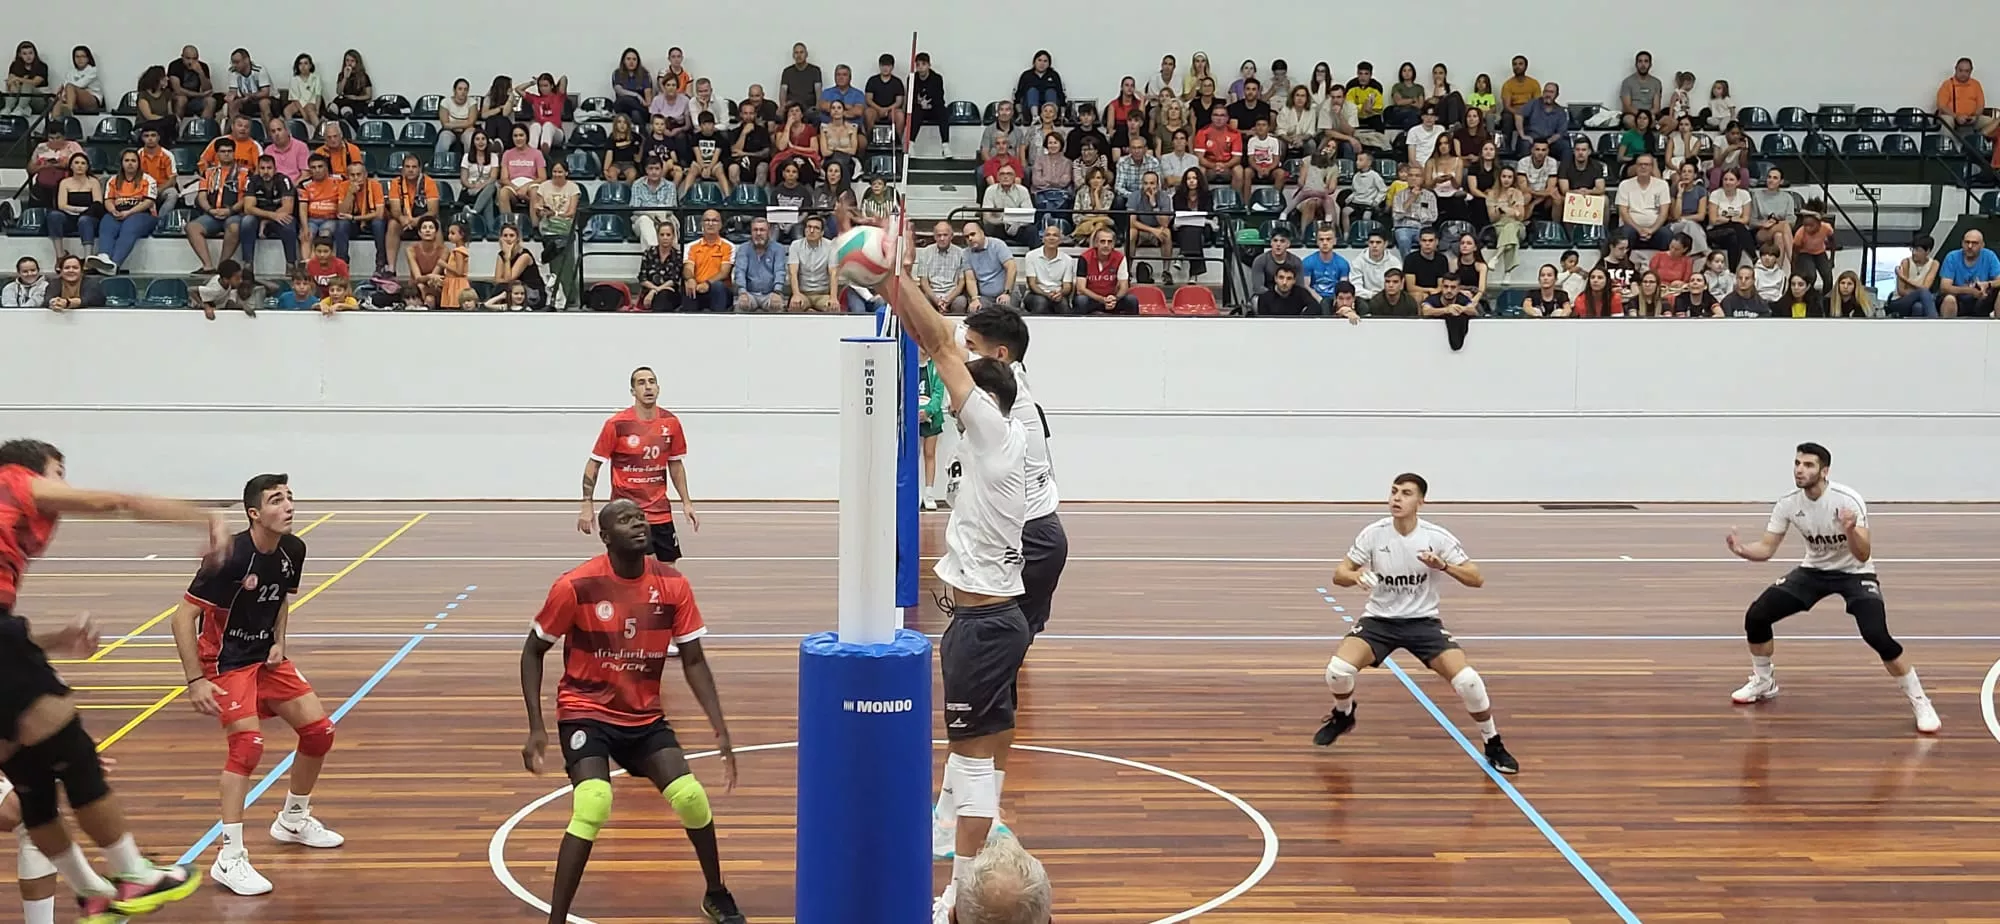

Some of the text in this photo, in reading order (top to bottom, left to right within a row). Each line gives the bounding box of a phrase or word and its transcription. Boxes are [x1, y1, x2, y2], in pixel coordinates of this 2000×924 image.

[864, 368, 875, 416] MONDO
[642, 445, 660, 460] 20
[257, 583, 280, 603] 22
[623, 617, 637, 639] 5
[856, 699, 913, 713] MONDO
